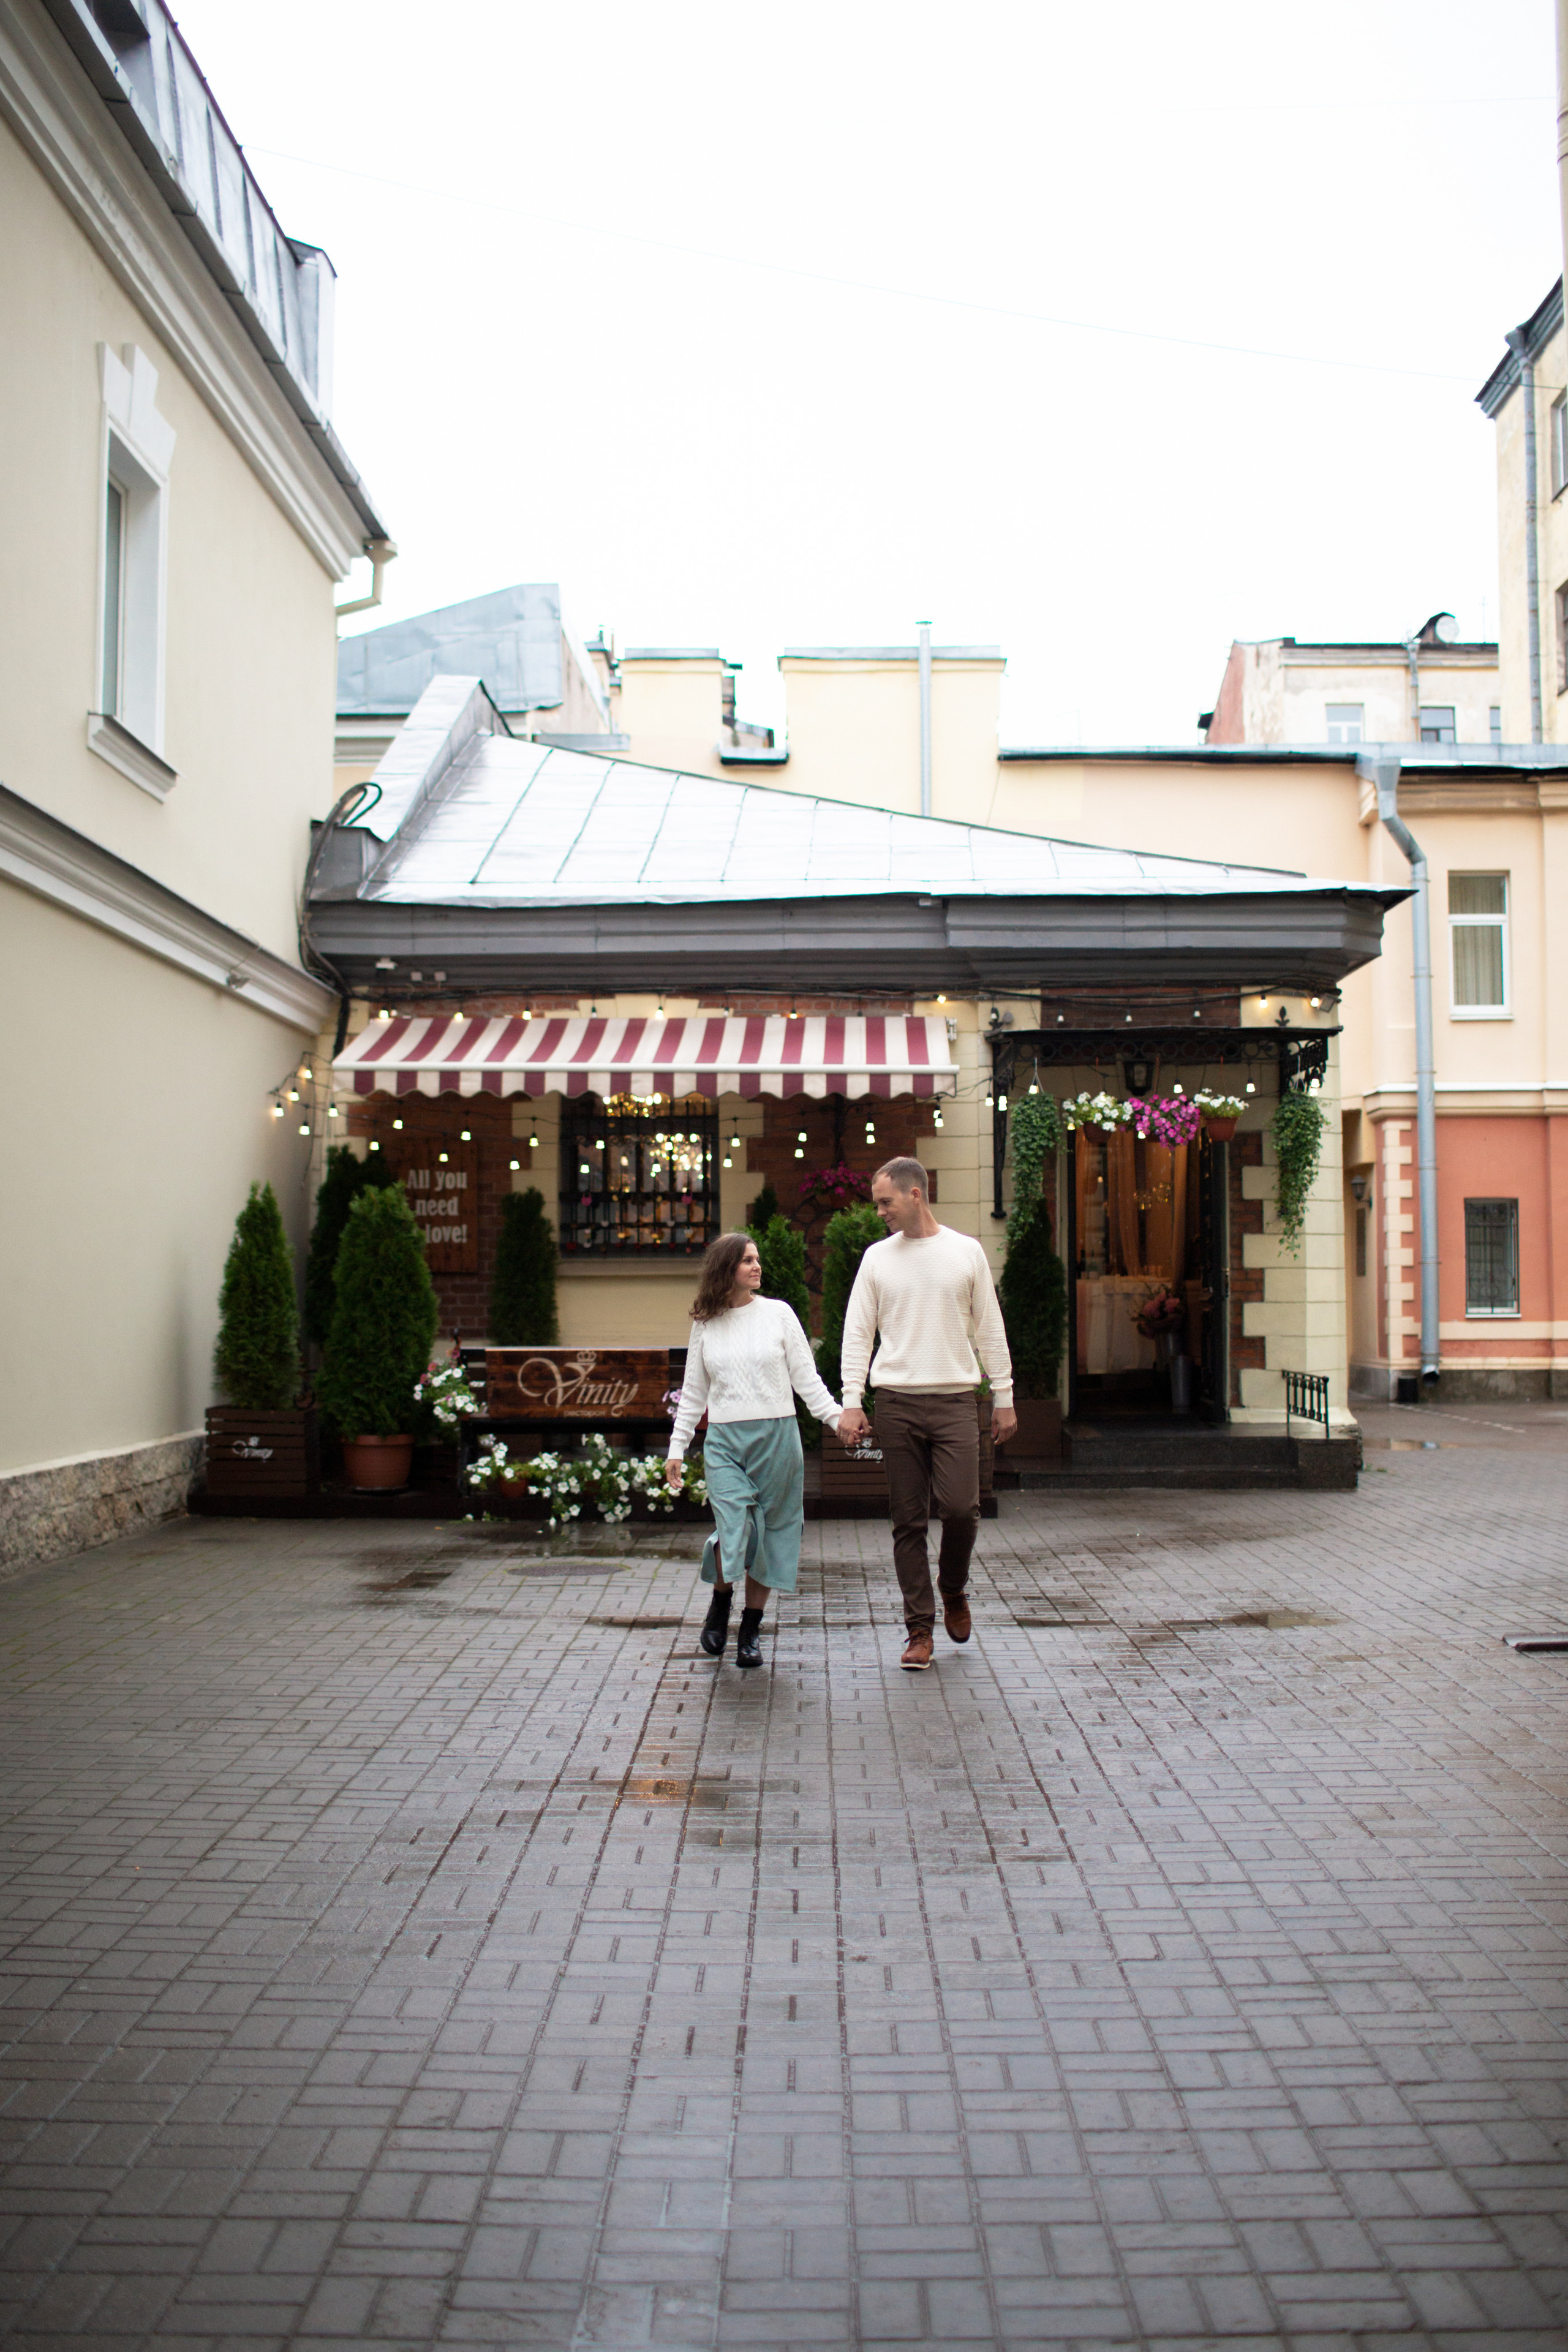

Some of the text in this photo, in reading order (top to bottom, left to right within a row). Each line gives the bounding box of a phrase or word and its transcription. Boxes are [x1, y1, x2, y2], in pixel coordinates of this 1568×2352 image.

[407, 1169, 468, 1191] All you
[415, 1196, 459, 1216] need
[424, 1223, 468, 1244] love!
[517, 1357, 639, 1418] Vinity
